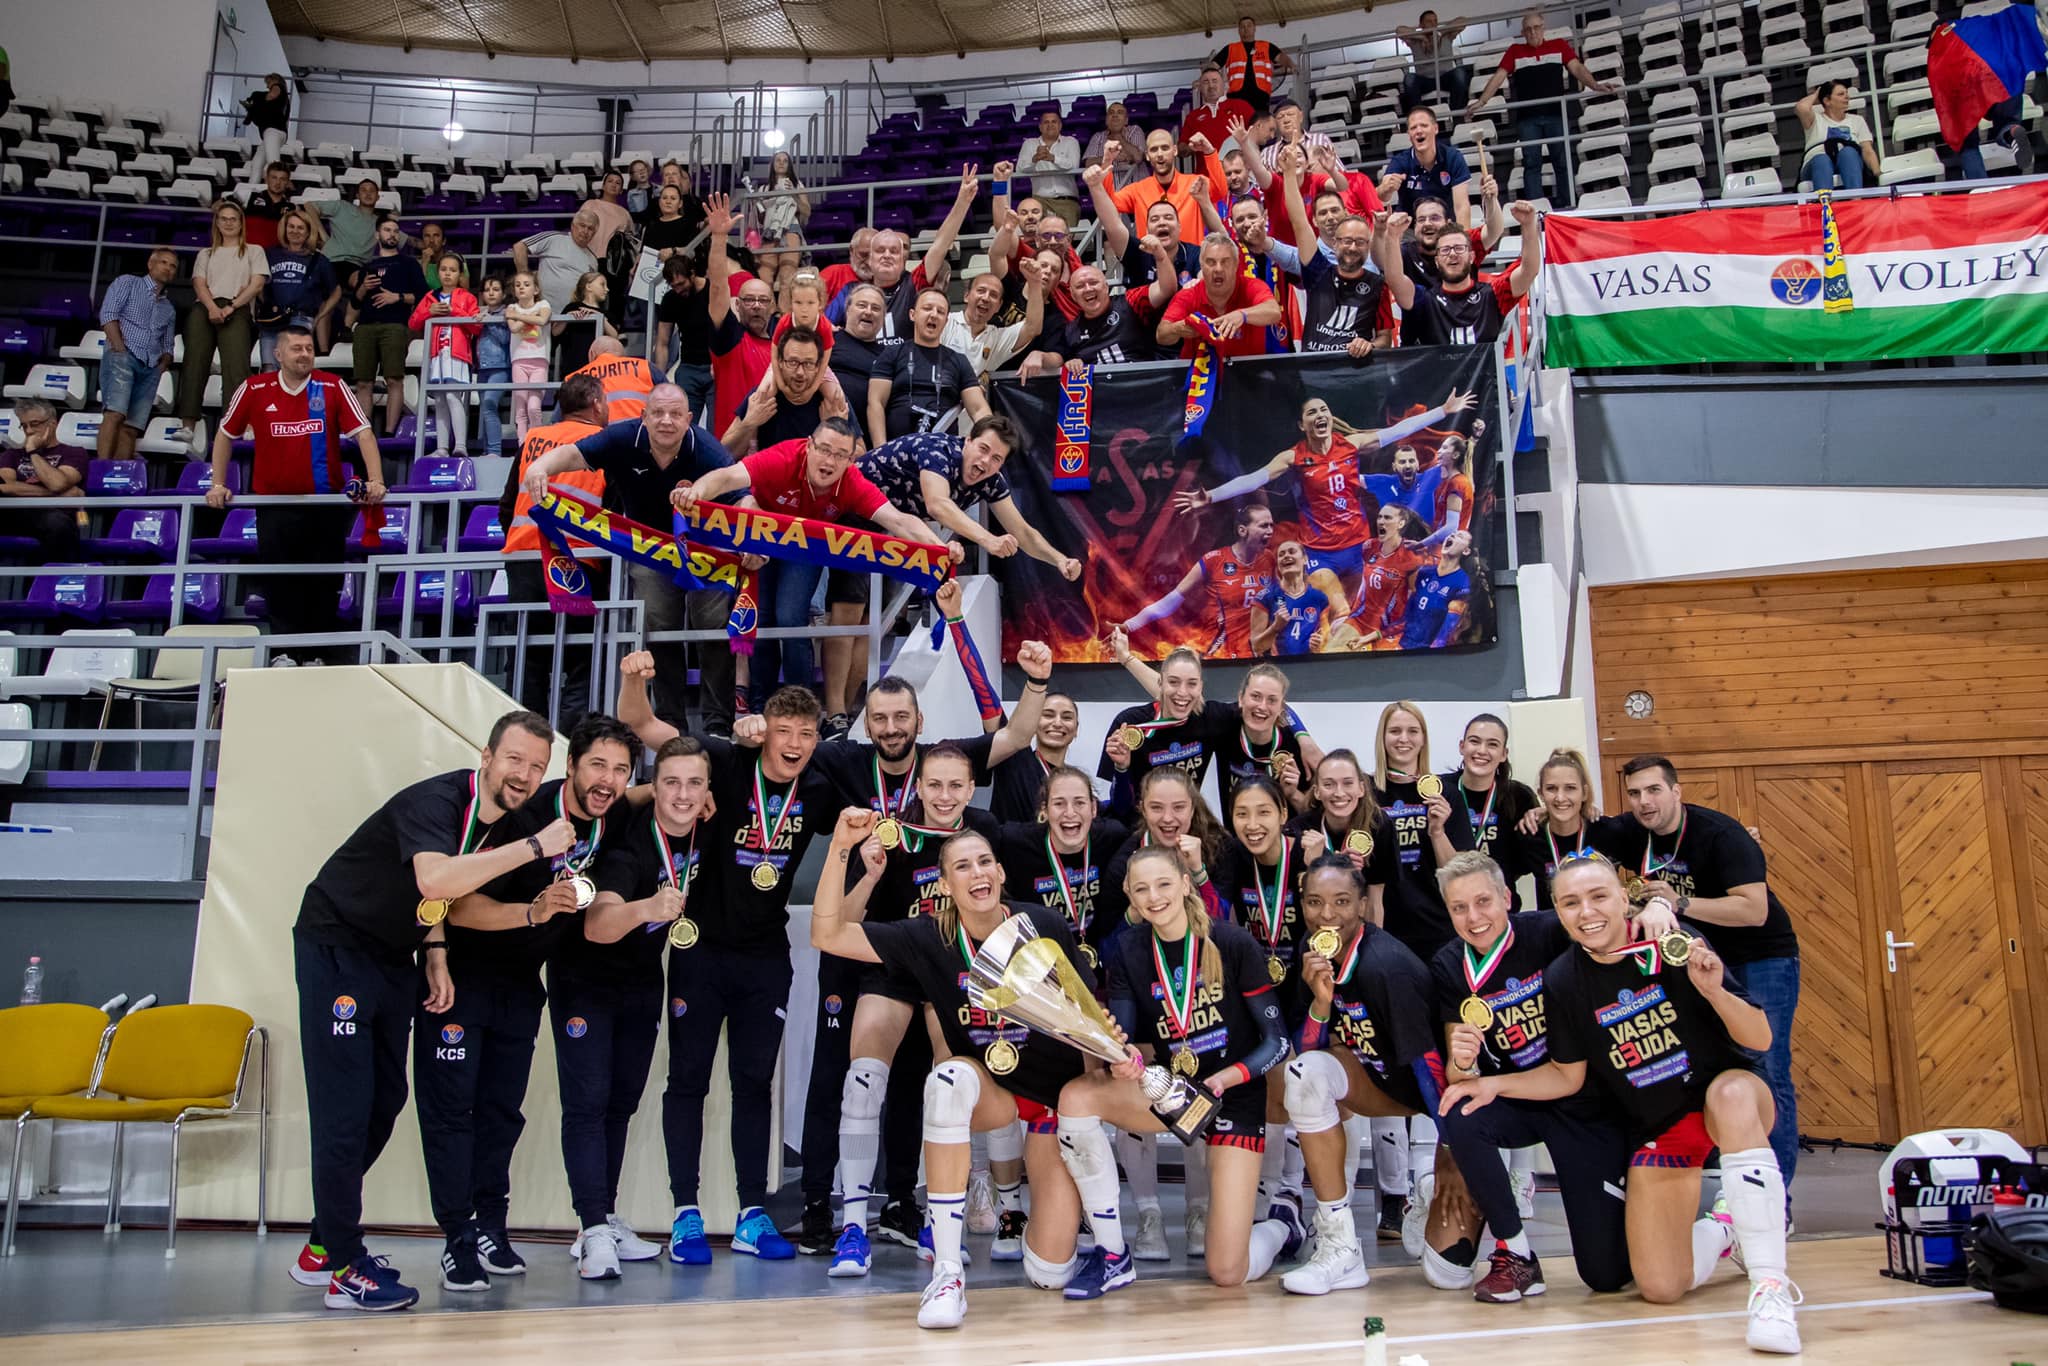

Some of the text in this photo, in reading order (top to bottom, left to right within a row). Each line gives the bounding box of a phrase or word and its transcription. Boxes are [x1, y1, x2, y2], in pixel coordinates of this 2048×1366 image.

[1590, 246, 2048, 299] VASAS VOLLEY
[1327, 473, 1346, 495] 18
[1418, 596, 1428, 610] 9
[1290, 621, 1301, 641] 4
[1601, 990, 1661, 1023] BAJNOKCSAPAT
[332, 1021, 356, 1036] KG
[828, 1016, 840, 1028] IA
[1609, 1001, 1678, 1046] VASAS
[436, 1047, 466, 1061] KCS
